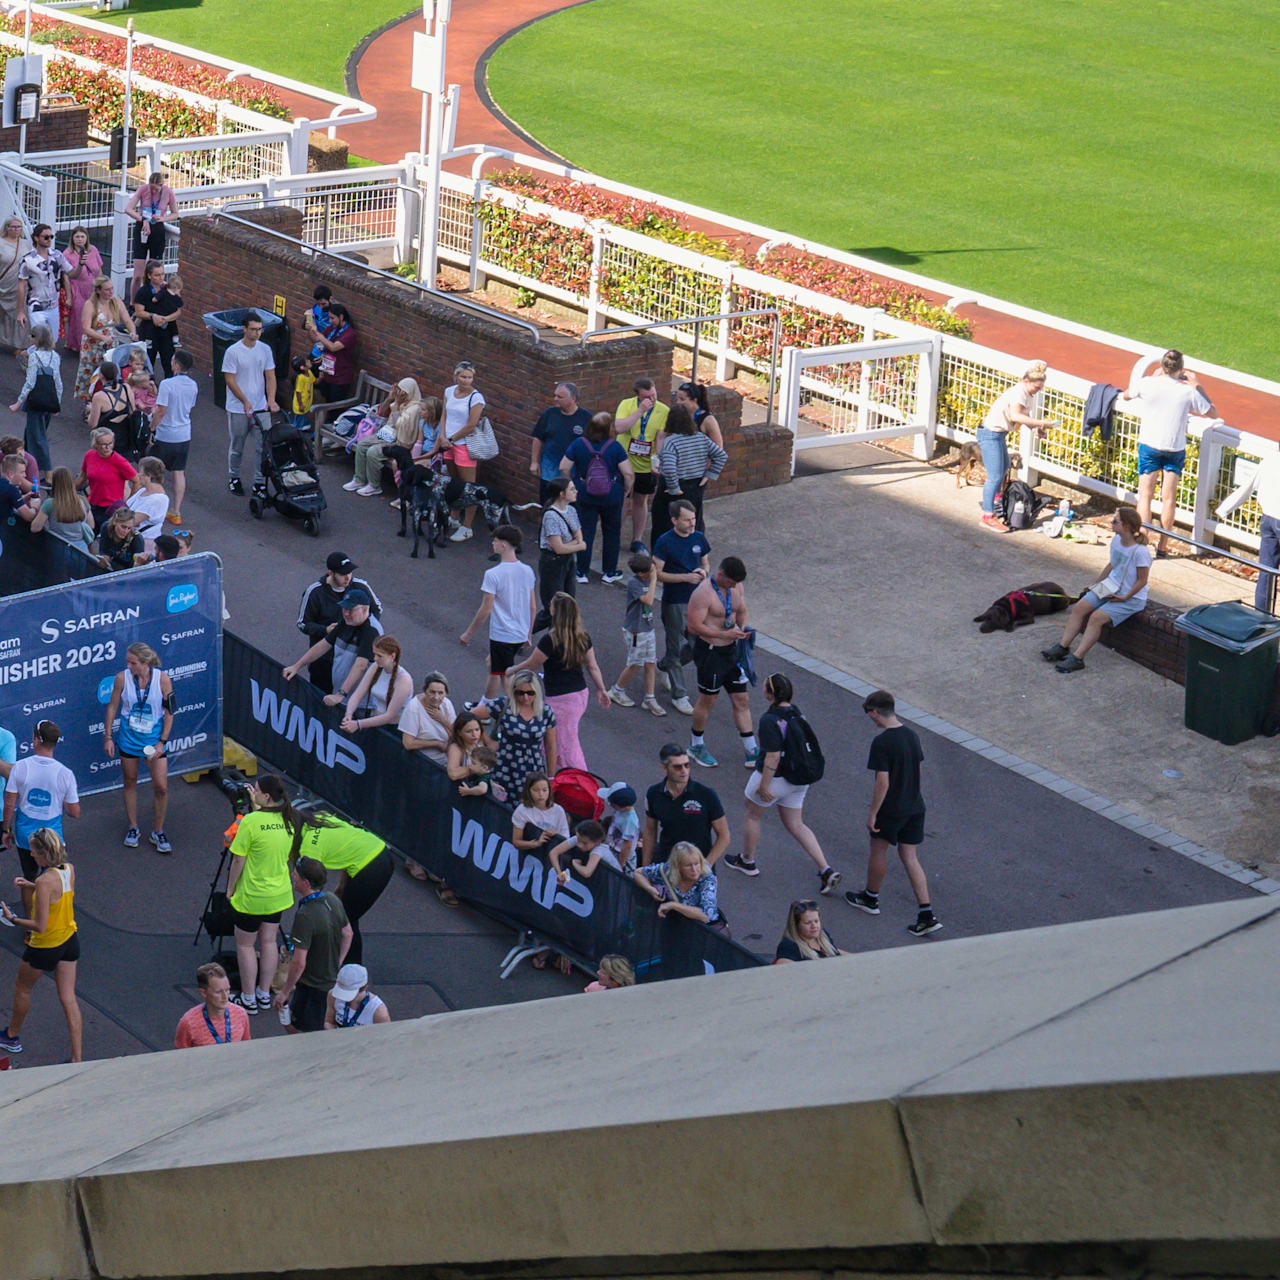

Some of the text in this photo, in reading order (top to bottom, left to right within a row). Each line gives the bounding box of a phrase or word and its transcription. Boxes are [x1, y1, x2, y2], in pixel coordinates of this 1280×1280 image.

[64, 605, 140, 634] SAFRAN
[171, 627, 205, 642] SAFRAN
[0, 648, 21, 663] SAFRAN
[65, 640, 117, 670] 2023
[178, 661, 208, 675] RUNNING
[32, 697, 66, 712] SAFRAN
[249, 676, 367, 777] WMP
[451, 806, 595, 918] WMP
